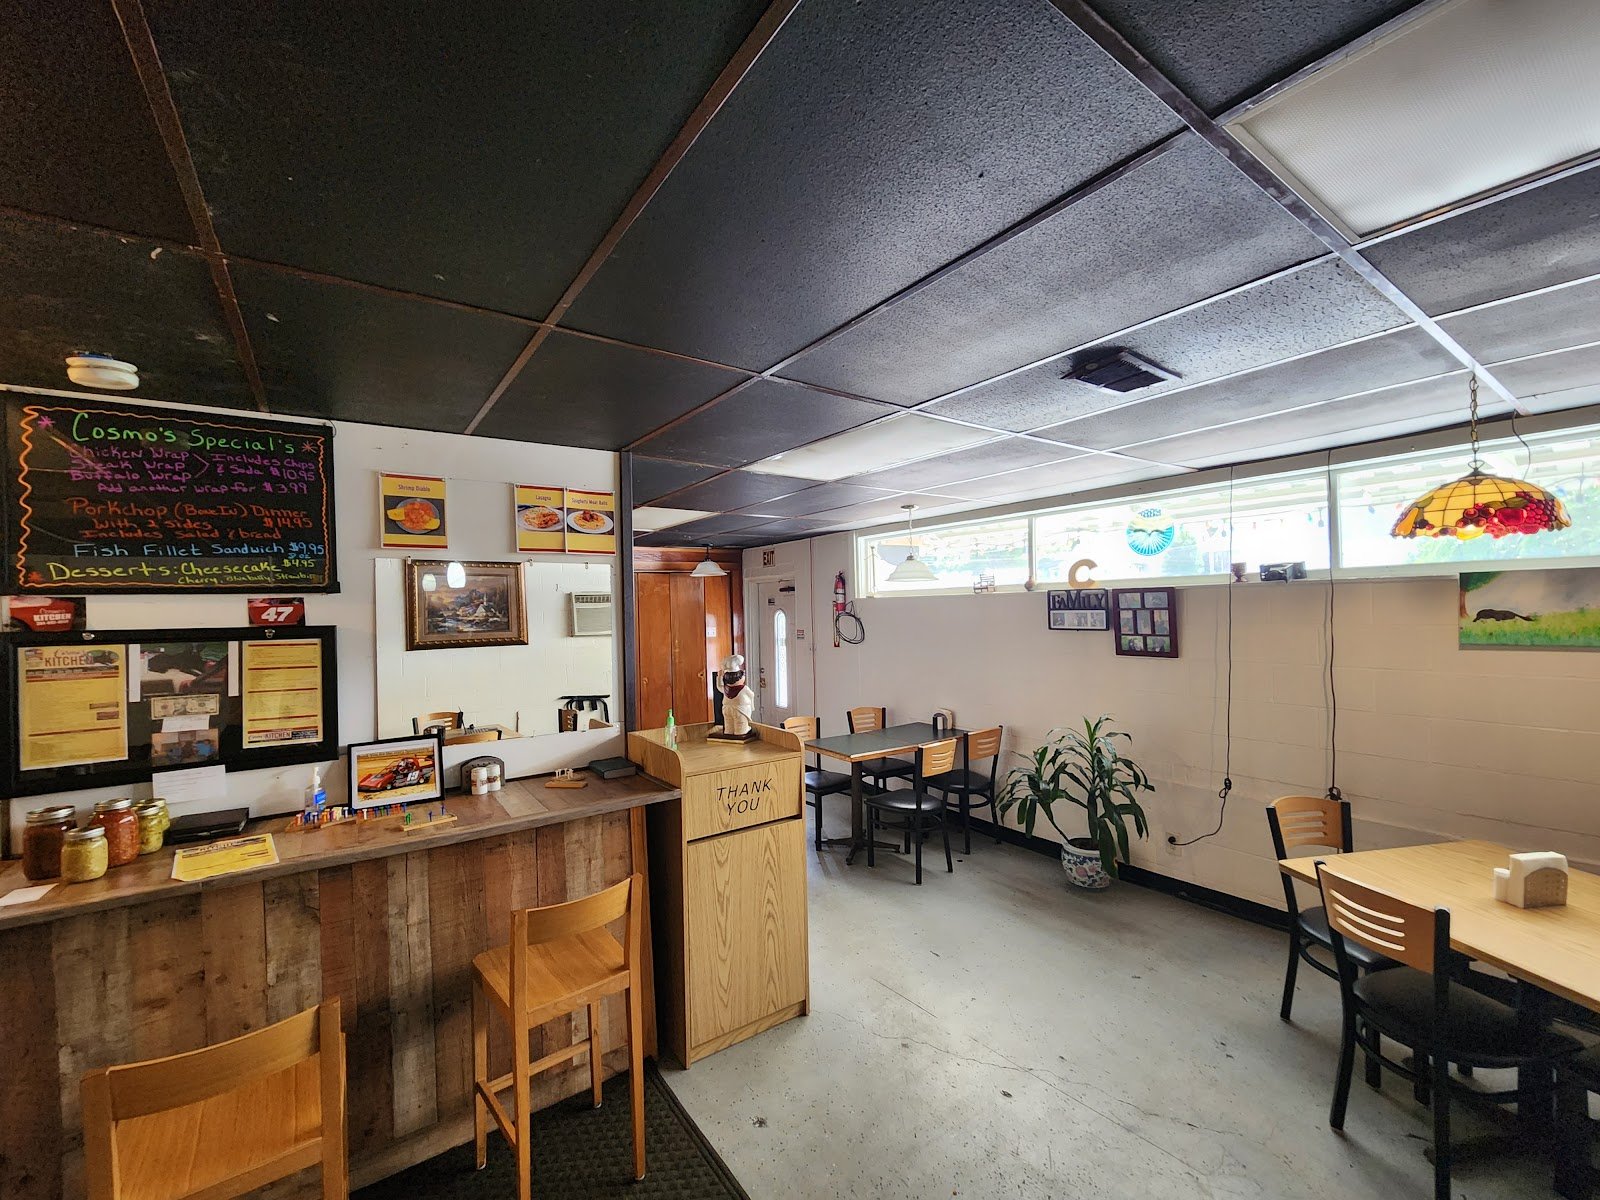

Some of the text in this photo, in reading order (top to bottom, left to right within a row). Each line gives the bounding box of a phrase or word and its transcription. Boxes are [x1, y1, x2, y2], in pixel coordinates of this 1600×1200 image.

[73, 412, 295, 454] Cosmo's Special's
[149, 447, 190, 462] Wrap
[211, 453, 316, 470] Includes Chips
[143, 461, 186, 472] Wrap
[269, 466, 316, 480] $10.95
[97, 482, 123, 493] Add
[129, 484, 188, 493] another
[262, 481, 308, 495] $3.99
[535, 494, 552, 502] Lasagna
[249, 504, 309, 518] Dinner
[262, 517, 314, 529] $14.95
[80, 529, 164, 540] Includes
[238, 527, 282, 540] bread
[73, 541, 325, 558] Fish Fillet Sandwich $9.95
[281, 558, 317, 568] $4.95
[763, 550, 775, 566] EXIT
[1068, 559, 1098, 588] C
[261, 606, 294, 622] 47
[717, 778, 772, 801] THANK
[727, 797, 760, 816] YOU
